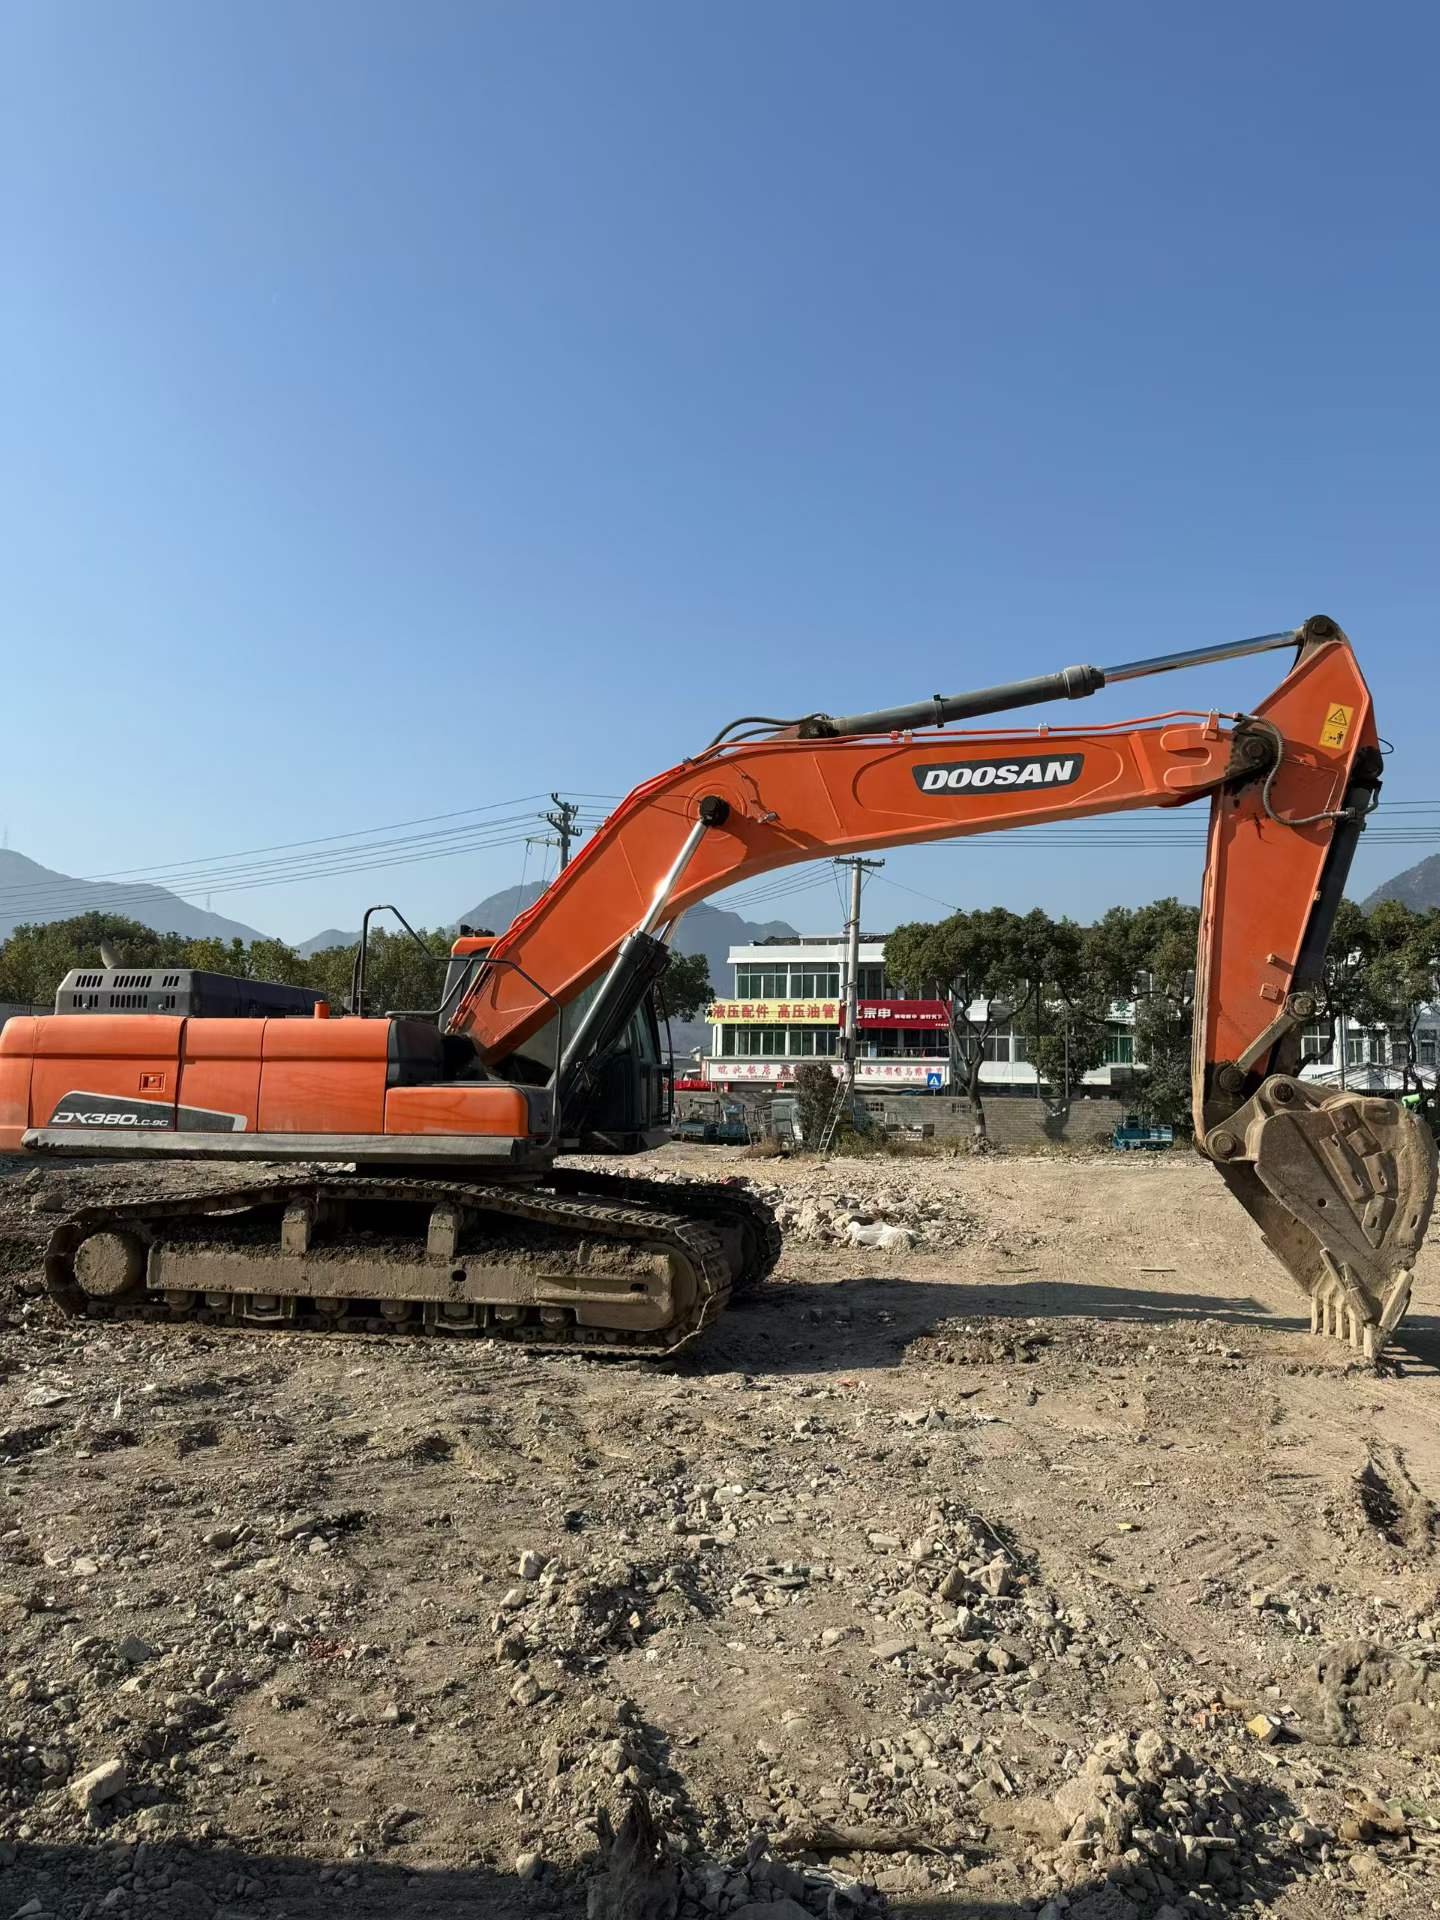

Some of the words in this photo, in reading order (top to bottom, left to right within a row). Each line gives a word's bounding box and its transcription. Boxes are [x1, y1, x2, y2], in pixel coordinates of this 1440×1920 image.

[922, 760, 1074, 790] DOOSAN
[712, 1003, 769, 1018] 液压配件
[778, 1003, 836, 1018] 高压油管
